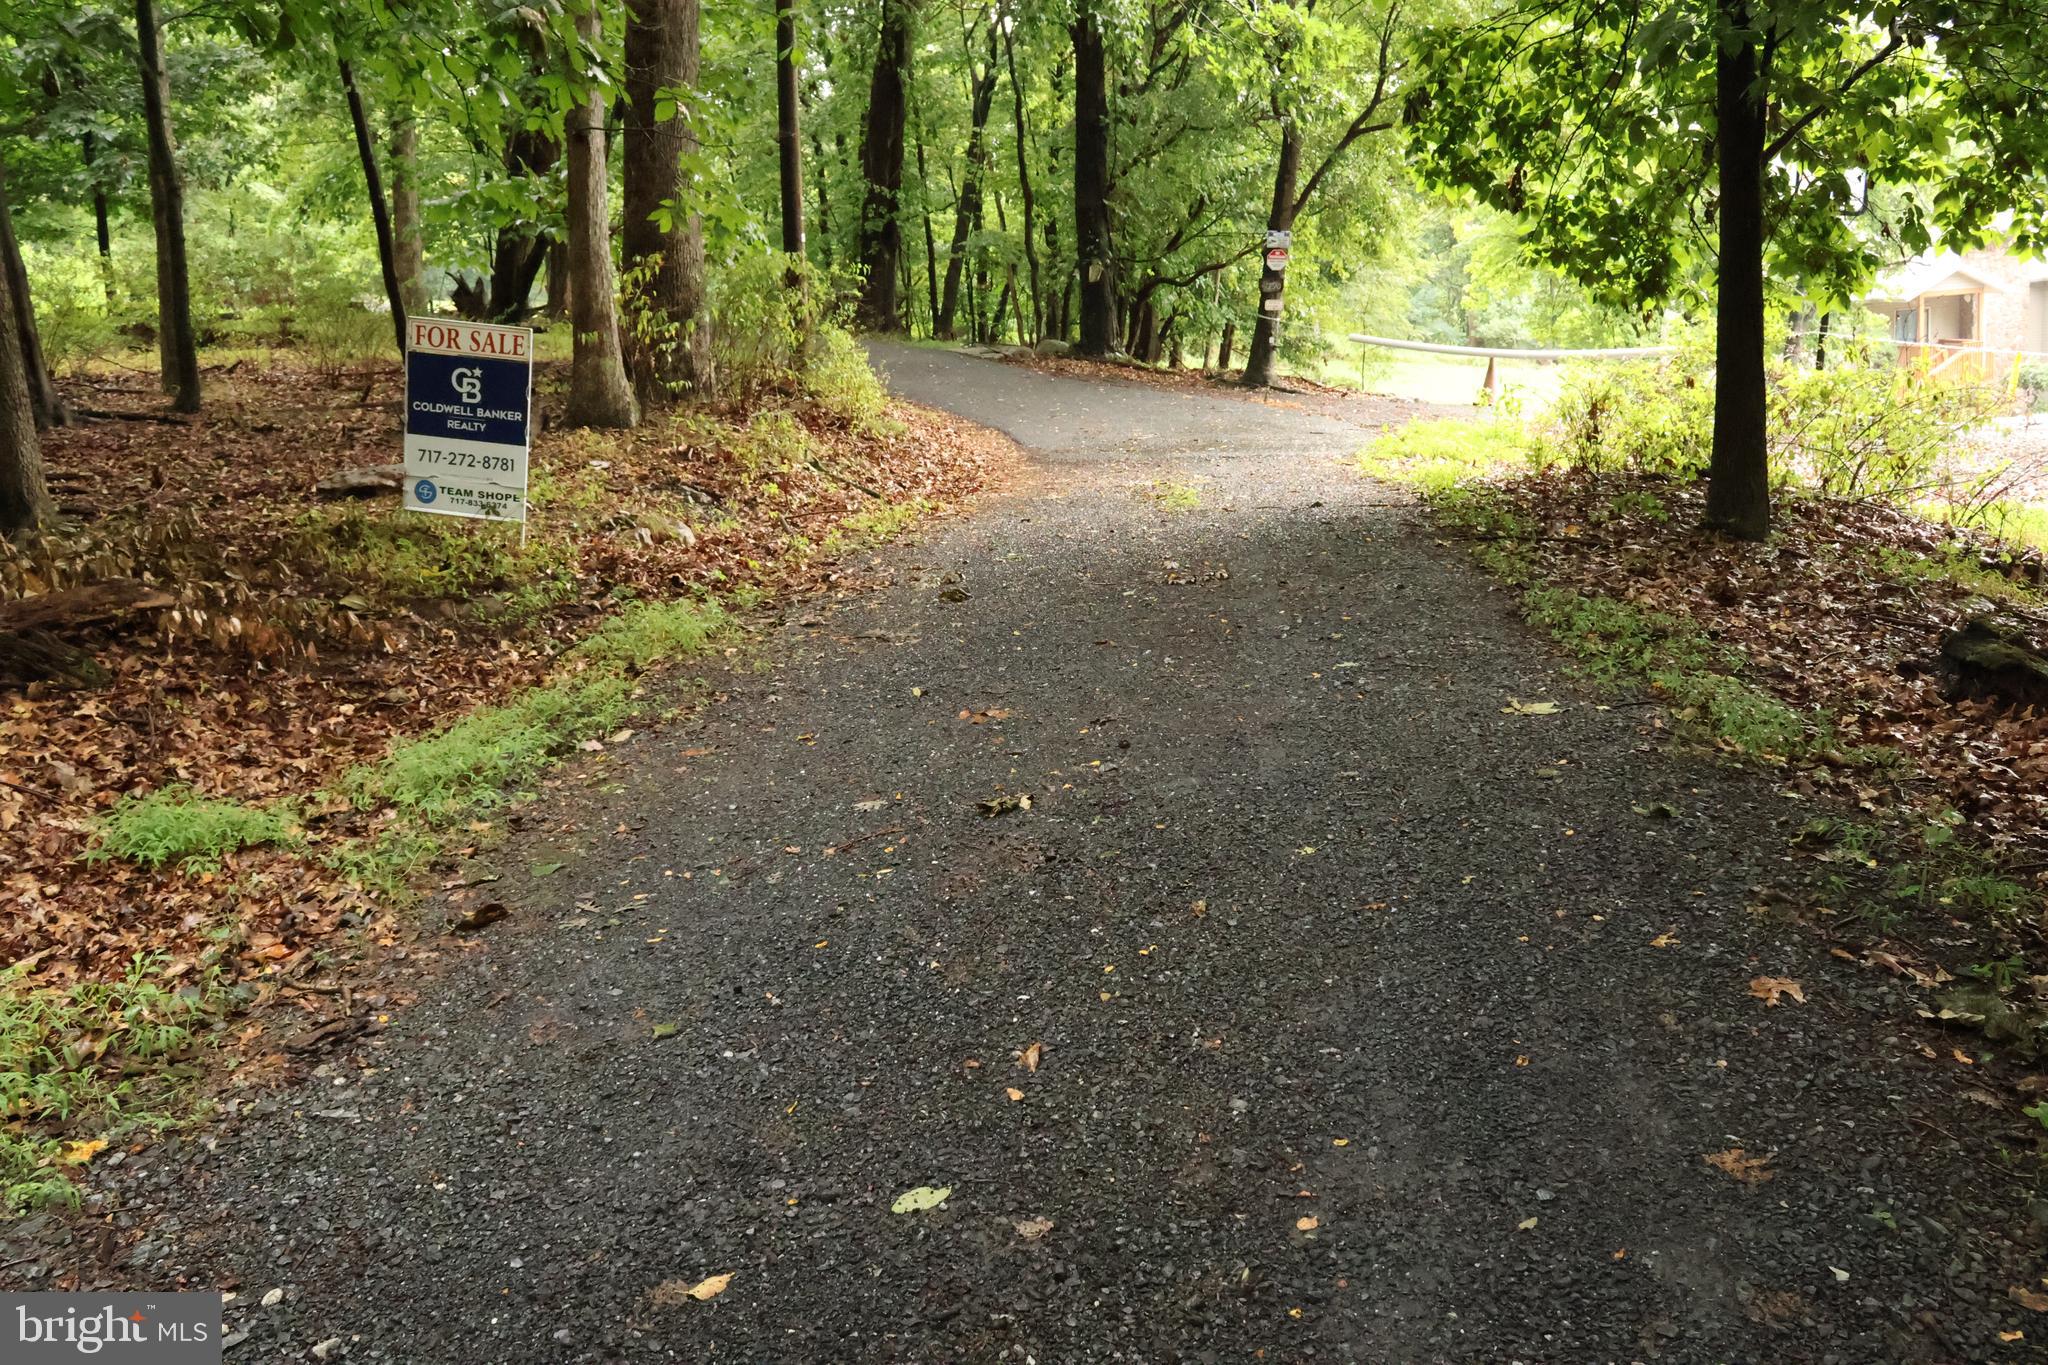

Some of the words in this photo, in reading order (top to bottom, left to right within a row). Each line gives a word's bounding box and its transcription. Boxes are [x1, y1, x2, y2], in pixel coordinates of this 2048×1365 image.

[415, 324, 461, 350] FOR
[469, 330, 525, 356] SALE
[451, 367, 482, 404] CB
[413, 401, 474, 416] COLDWELL
[477, 408, 522, 421] BANKER
[447, 420, 486, 432] REALTY
[418, 448, 515, 472] 717-272-8781
[439, 486, 473, 497] TEAM
[478, 491, 521, 502] SHOPE
